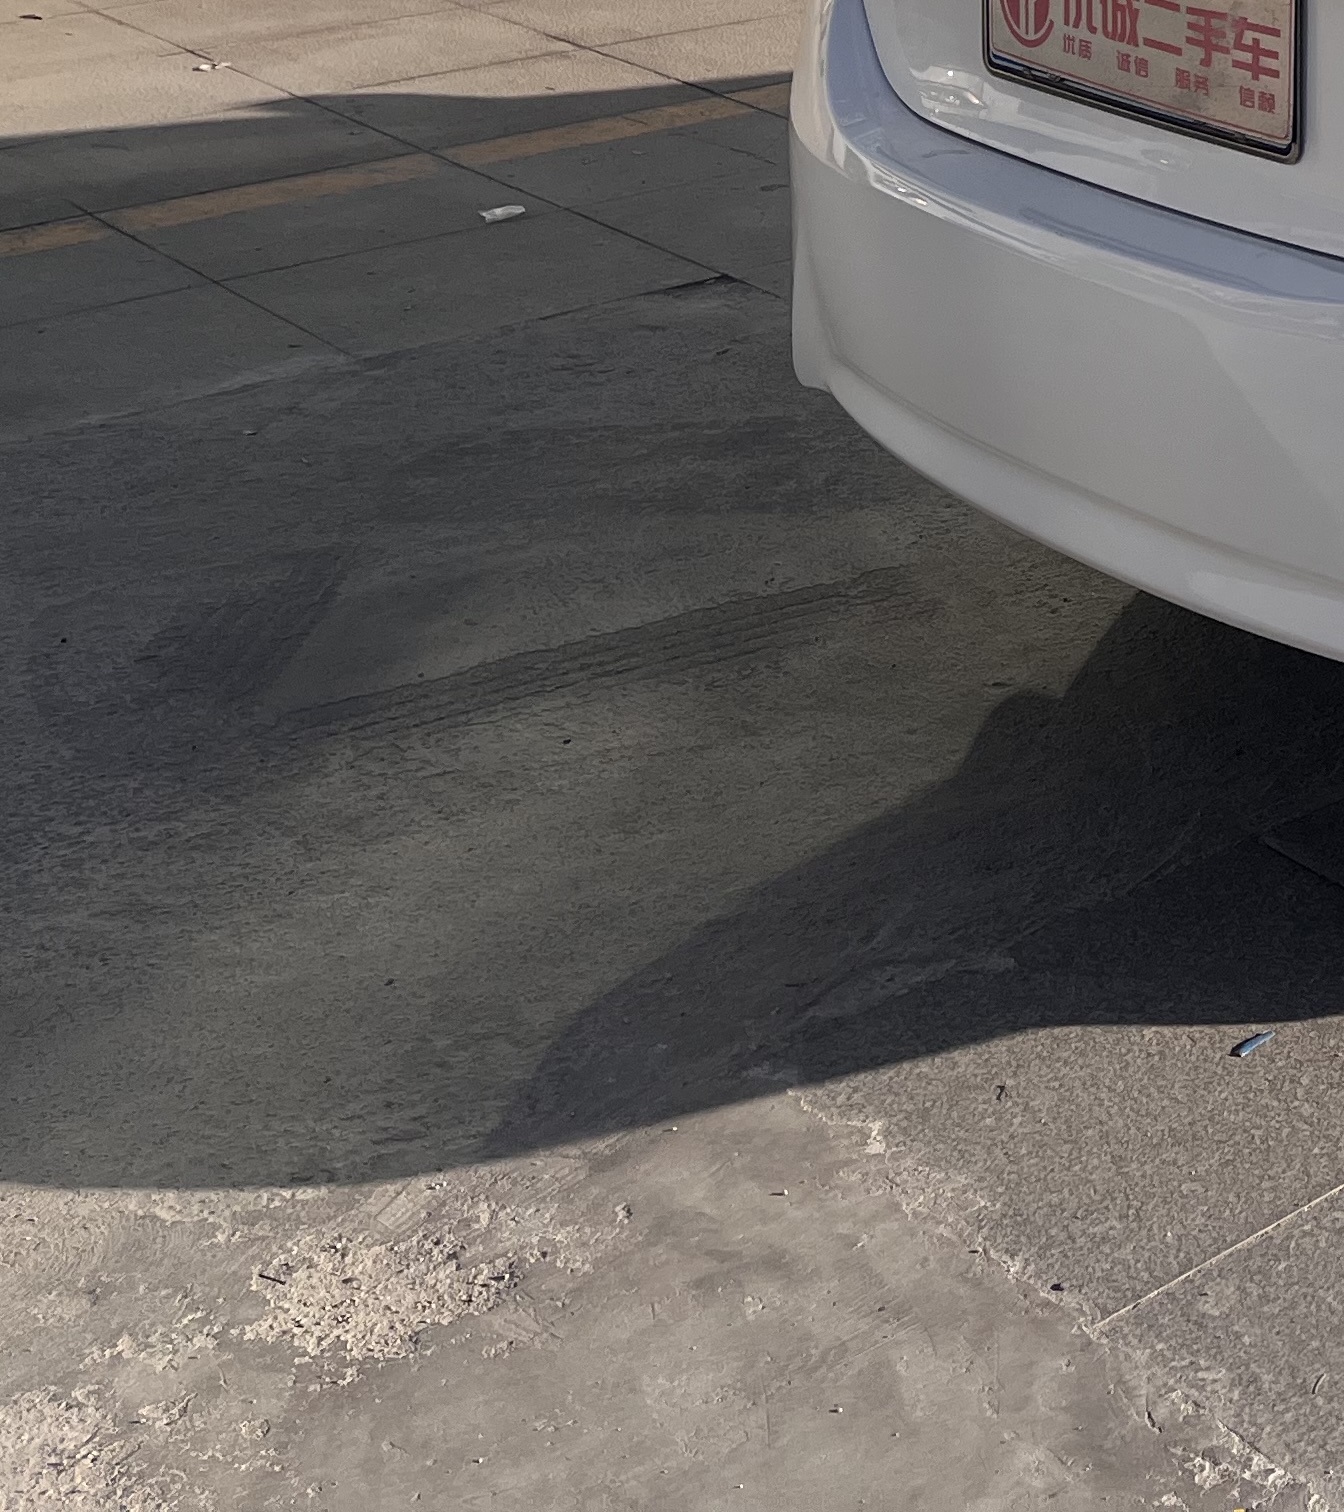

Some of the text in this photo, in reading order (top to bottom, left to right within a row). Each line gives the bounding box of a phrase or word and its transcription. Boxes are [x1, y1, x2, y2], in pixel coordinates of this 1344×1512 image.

[1062, 33, 1276, 115] 优质 诚信 服务 信赖
